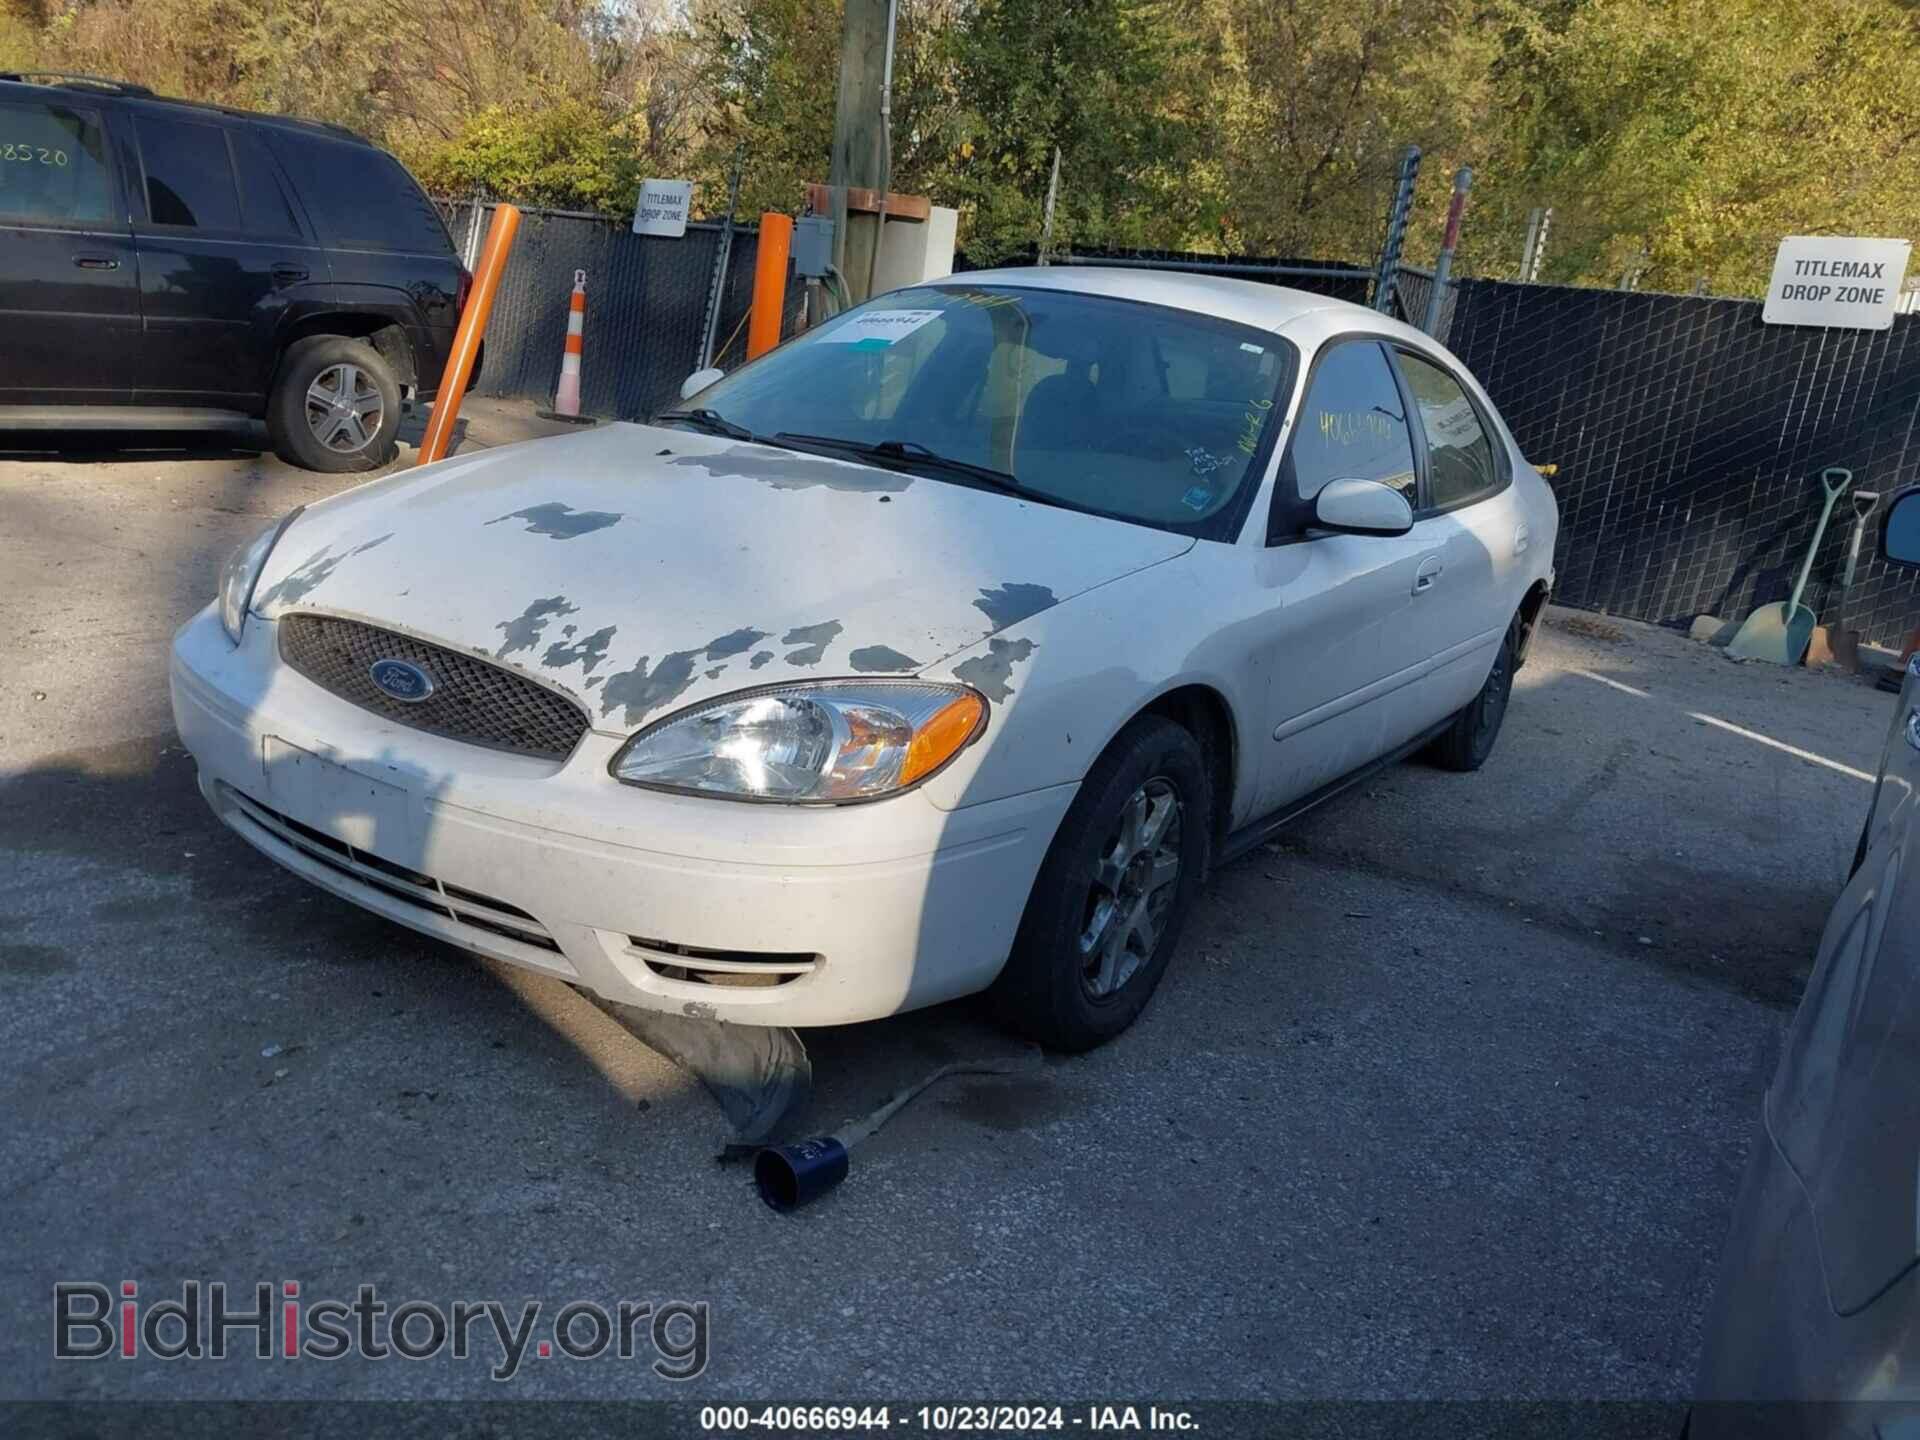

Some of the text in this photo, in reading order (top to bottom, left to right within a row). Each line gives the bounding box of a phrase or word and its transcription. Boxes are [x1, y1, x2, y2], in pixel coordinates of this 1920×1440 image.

[0, 143, 68, 166] 8520
[647, 193, 682, 206] TITLEMAX
[641, 208, 682, 221] DROP ZONE
[1794, 260, 1885, 279] TITLEMAX
[1781, 284, 1885, 304] DROP ZONE
[382, 666, 415, 692] Ford
